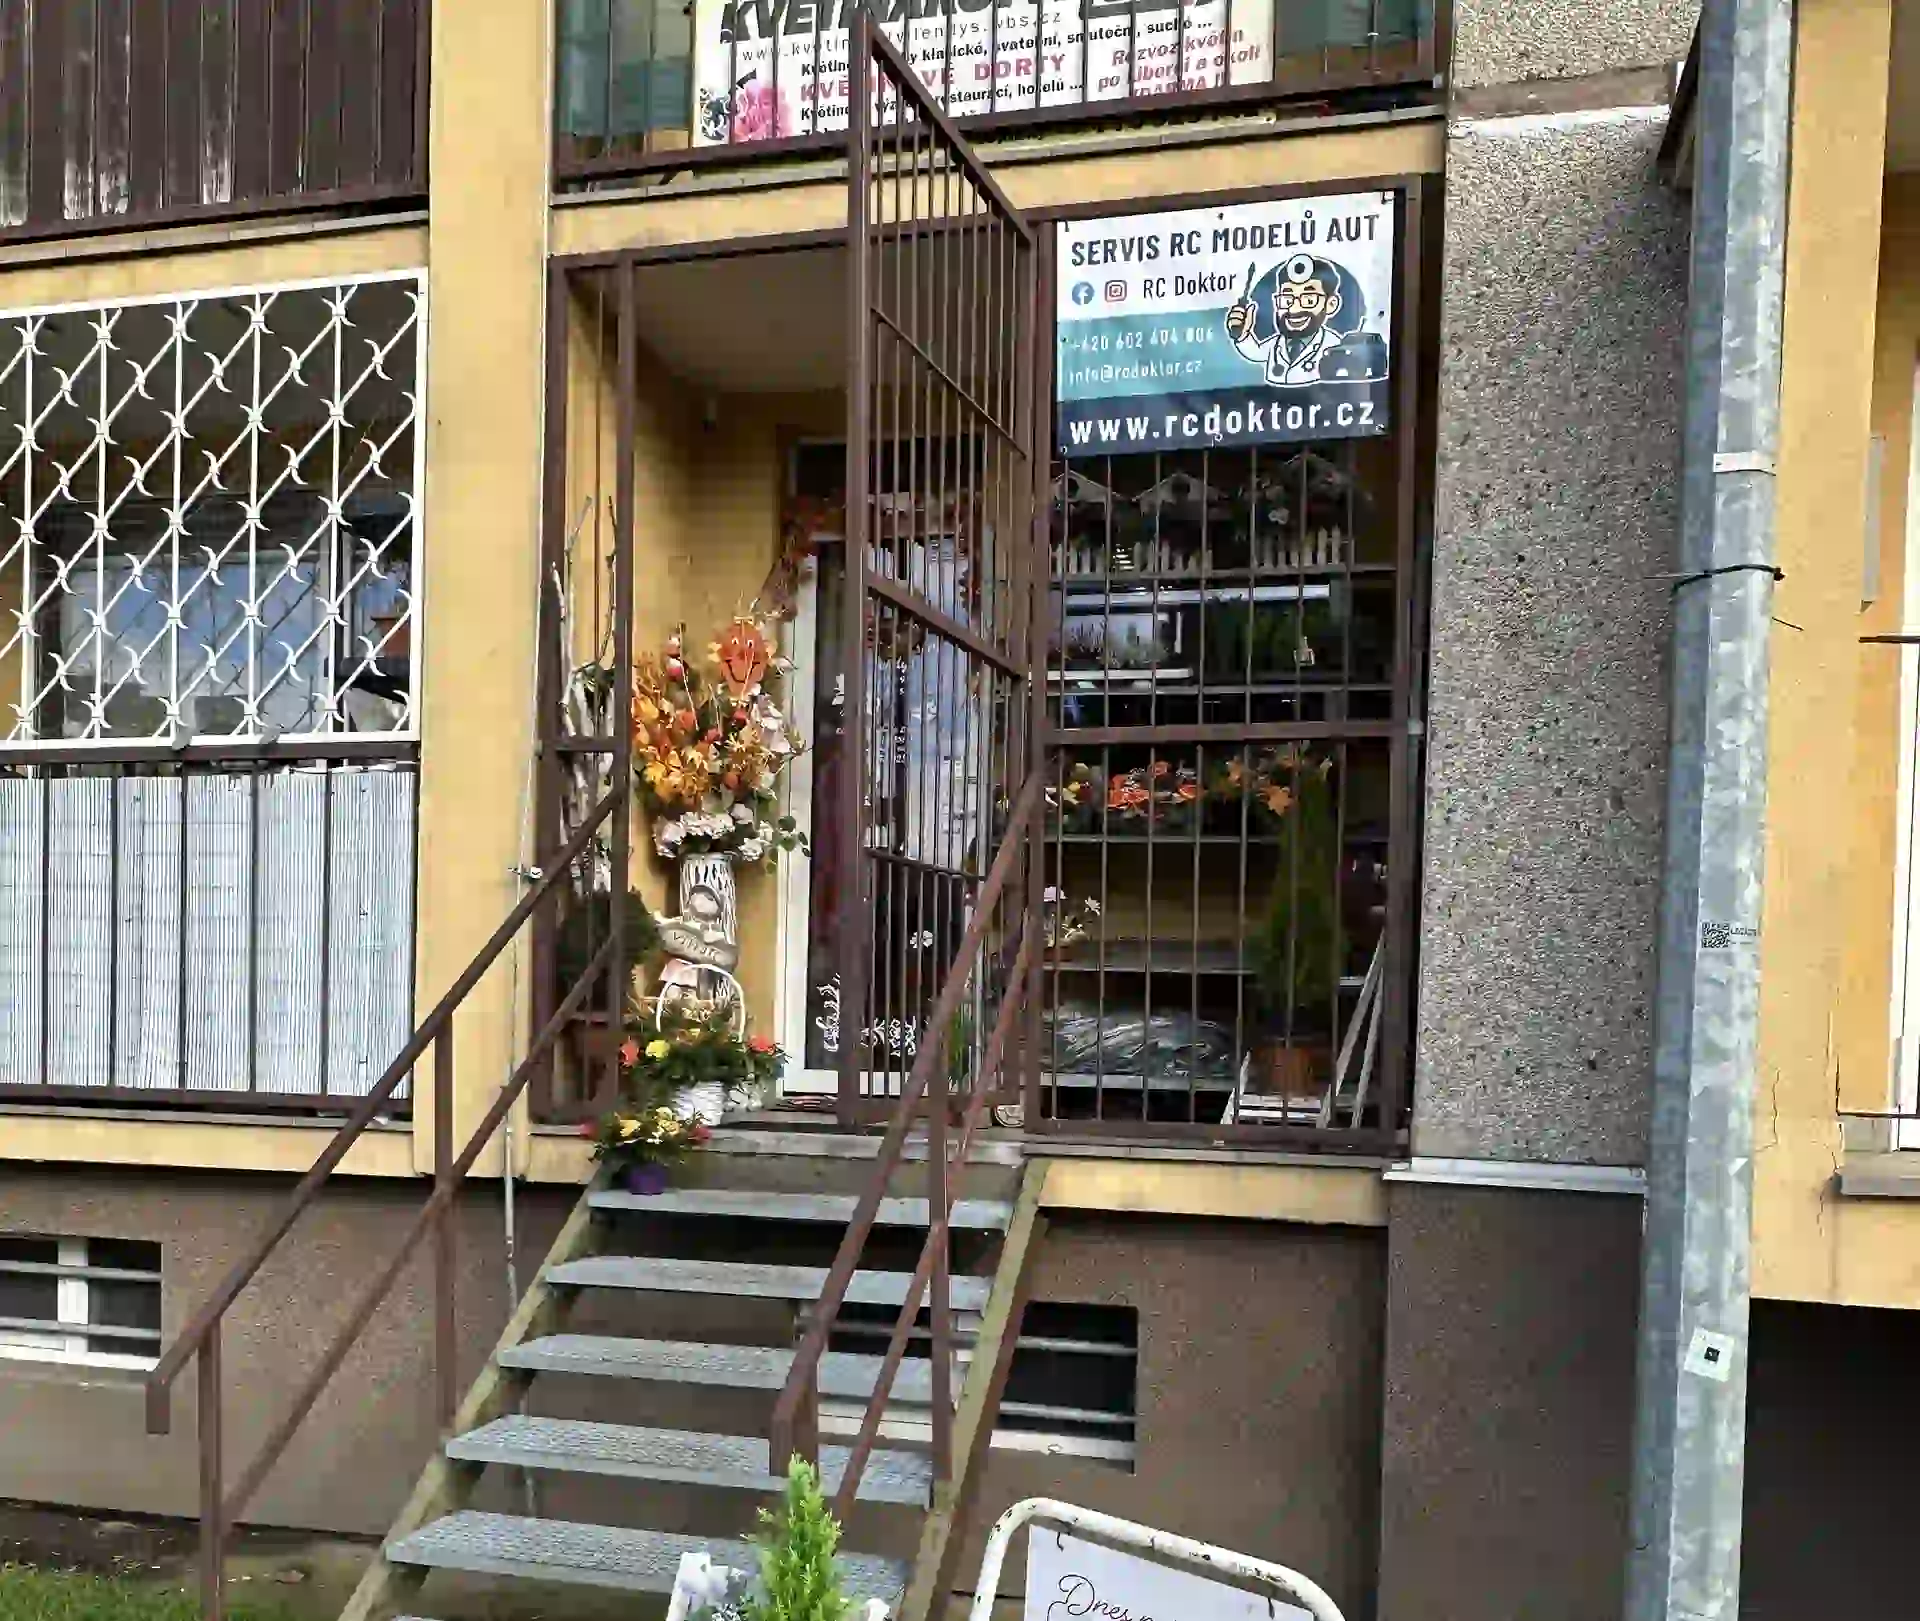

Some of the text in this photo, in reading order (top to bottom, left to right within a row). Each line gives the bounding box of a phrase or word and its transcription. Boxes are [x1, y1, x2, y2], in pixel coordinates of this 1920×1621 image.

[1185, 28, 1244, 52] květn
[1018, 77, 1064, 97] hoelů
[1071, 210, 1380, 267] SERVIS RC MODELŮ AUT
[1143, 271, 1237, 300] RC Doktor
[1070, 401, 1376, 445] www.rcdoktor.cz
